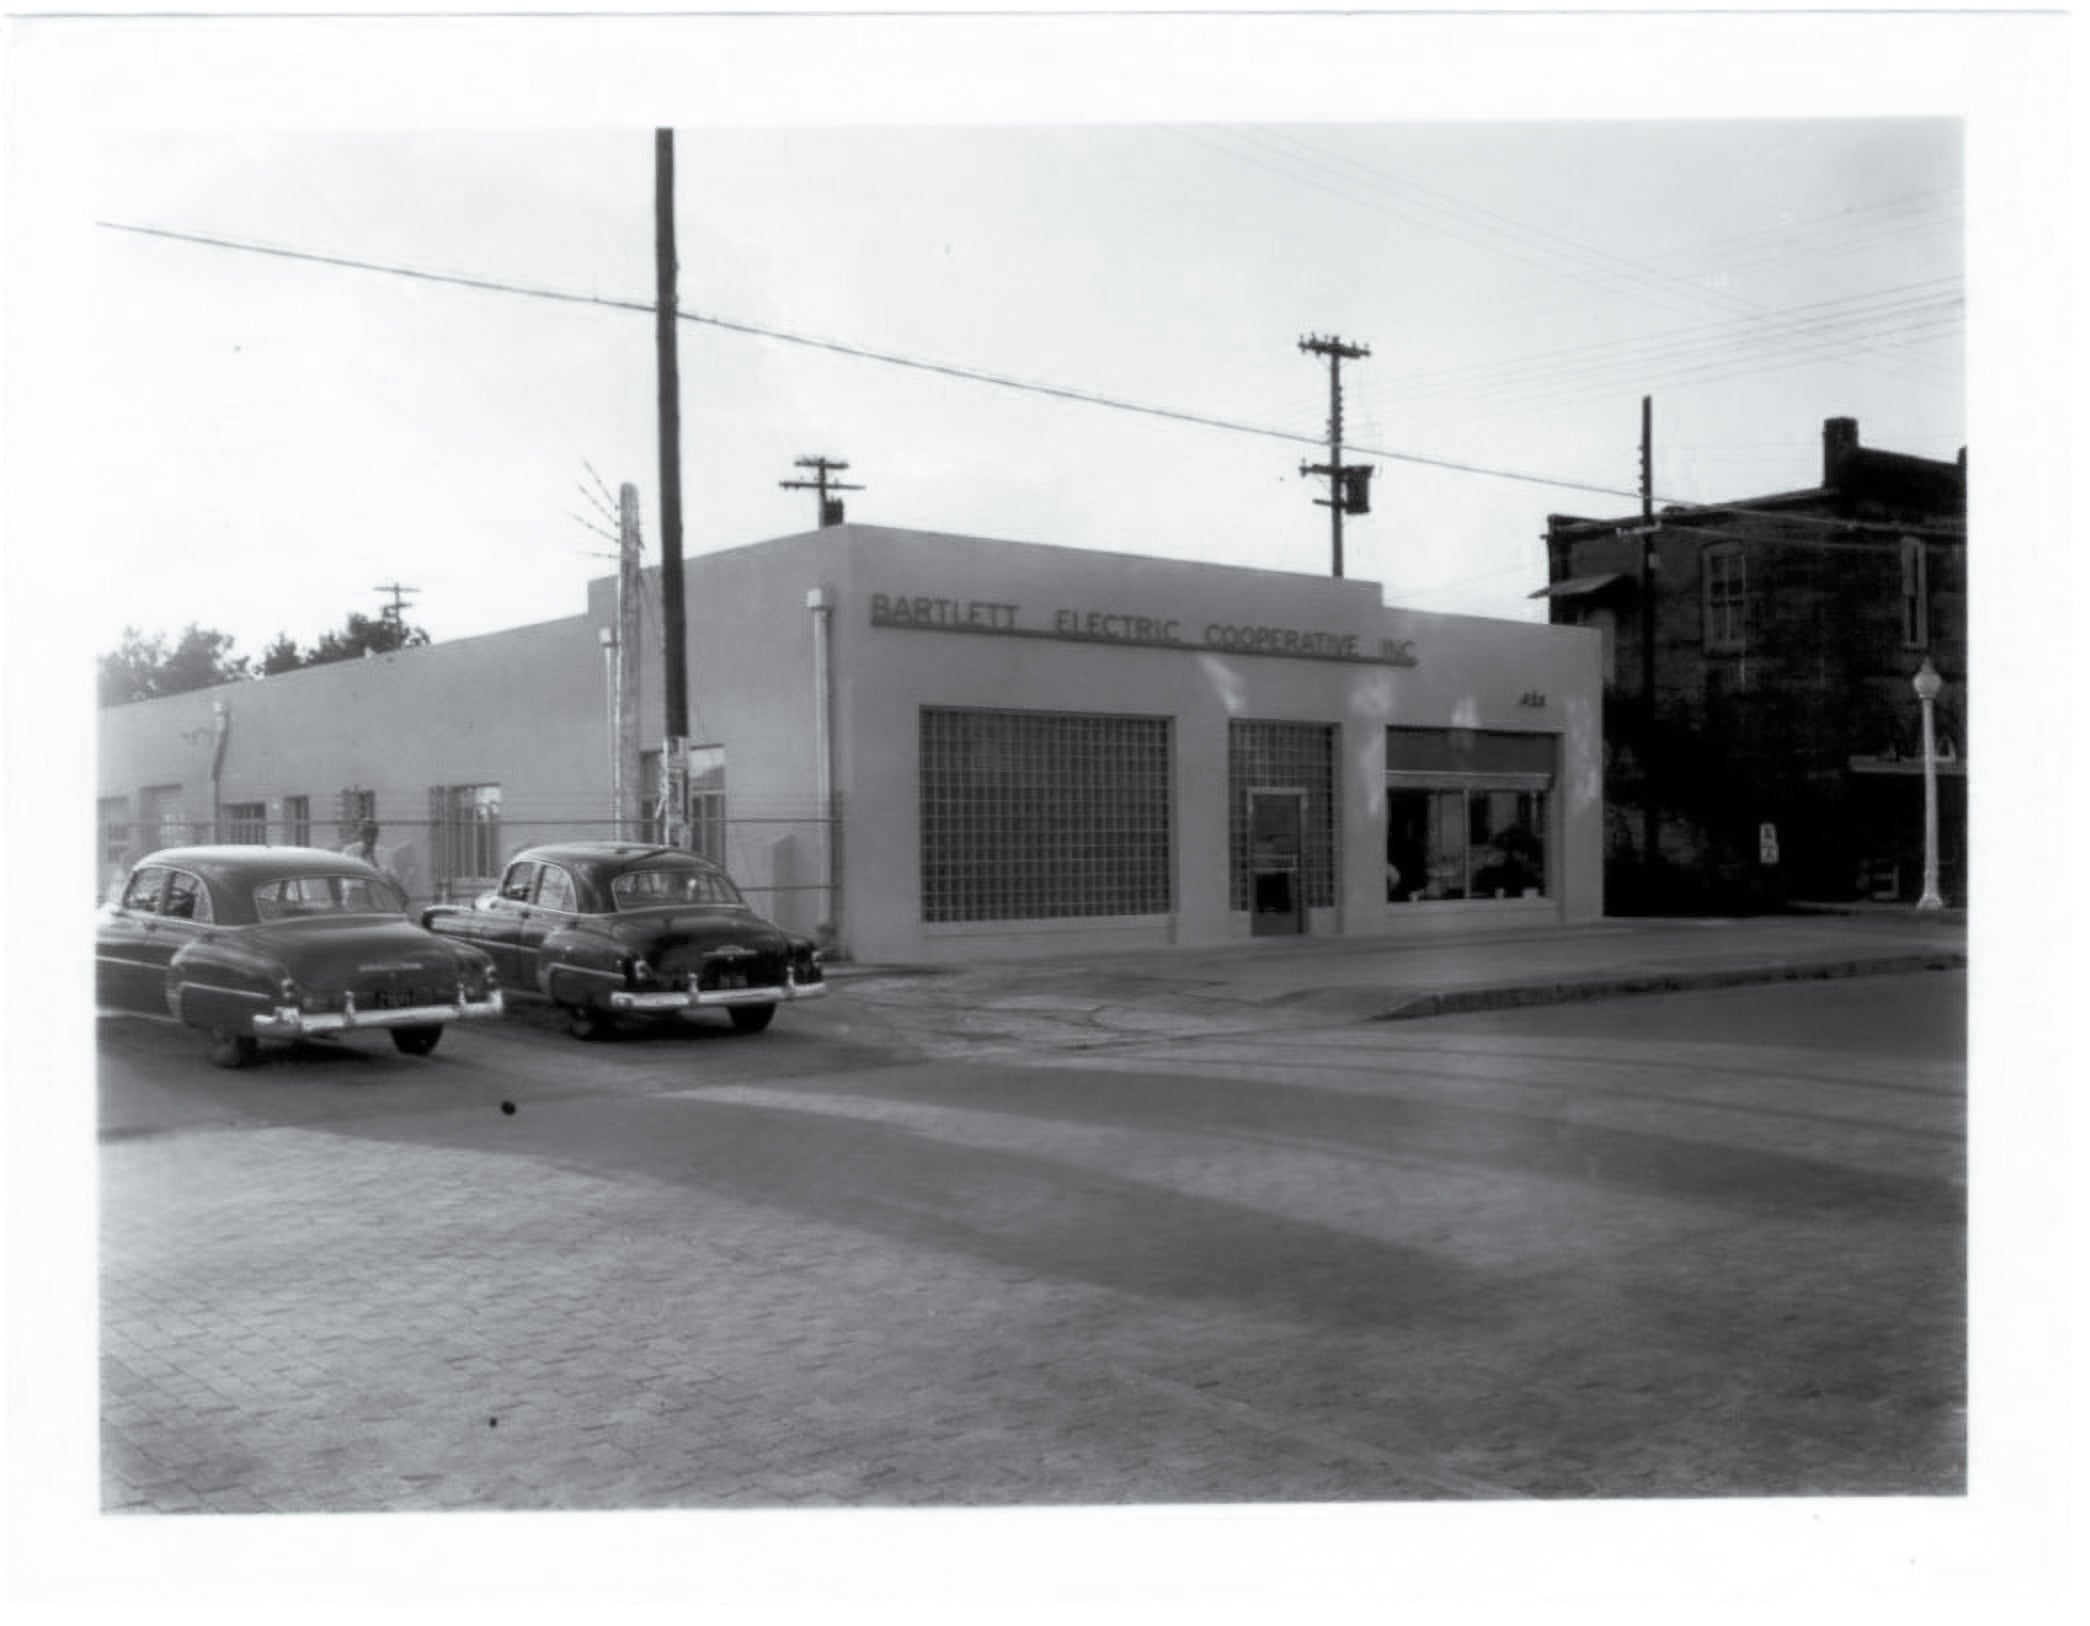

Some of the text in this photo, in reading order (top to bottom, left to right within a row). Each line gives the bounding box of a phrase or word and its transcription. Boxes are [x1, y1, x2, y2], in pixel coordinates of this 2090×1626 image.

[871, 593, 1021, 629] BARTLETT
[1055, 609, 1180, 645] ELECTRIC
[1204, 623, 1359, 659] COOPERATIVE
